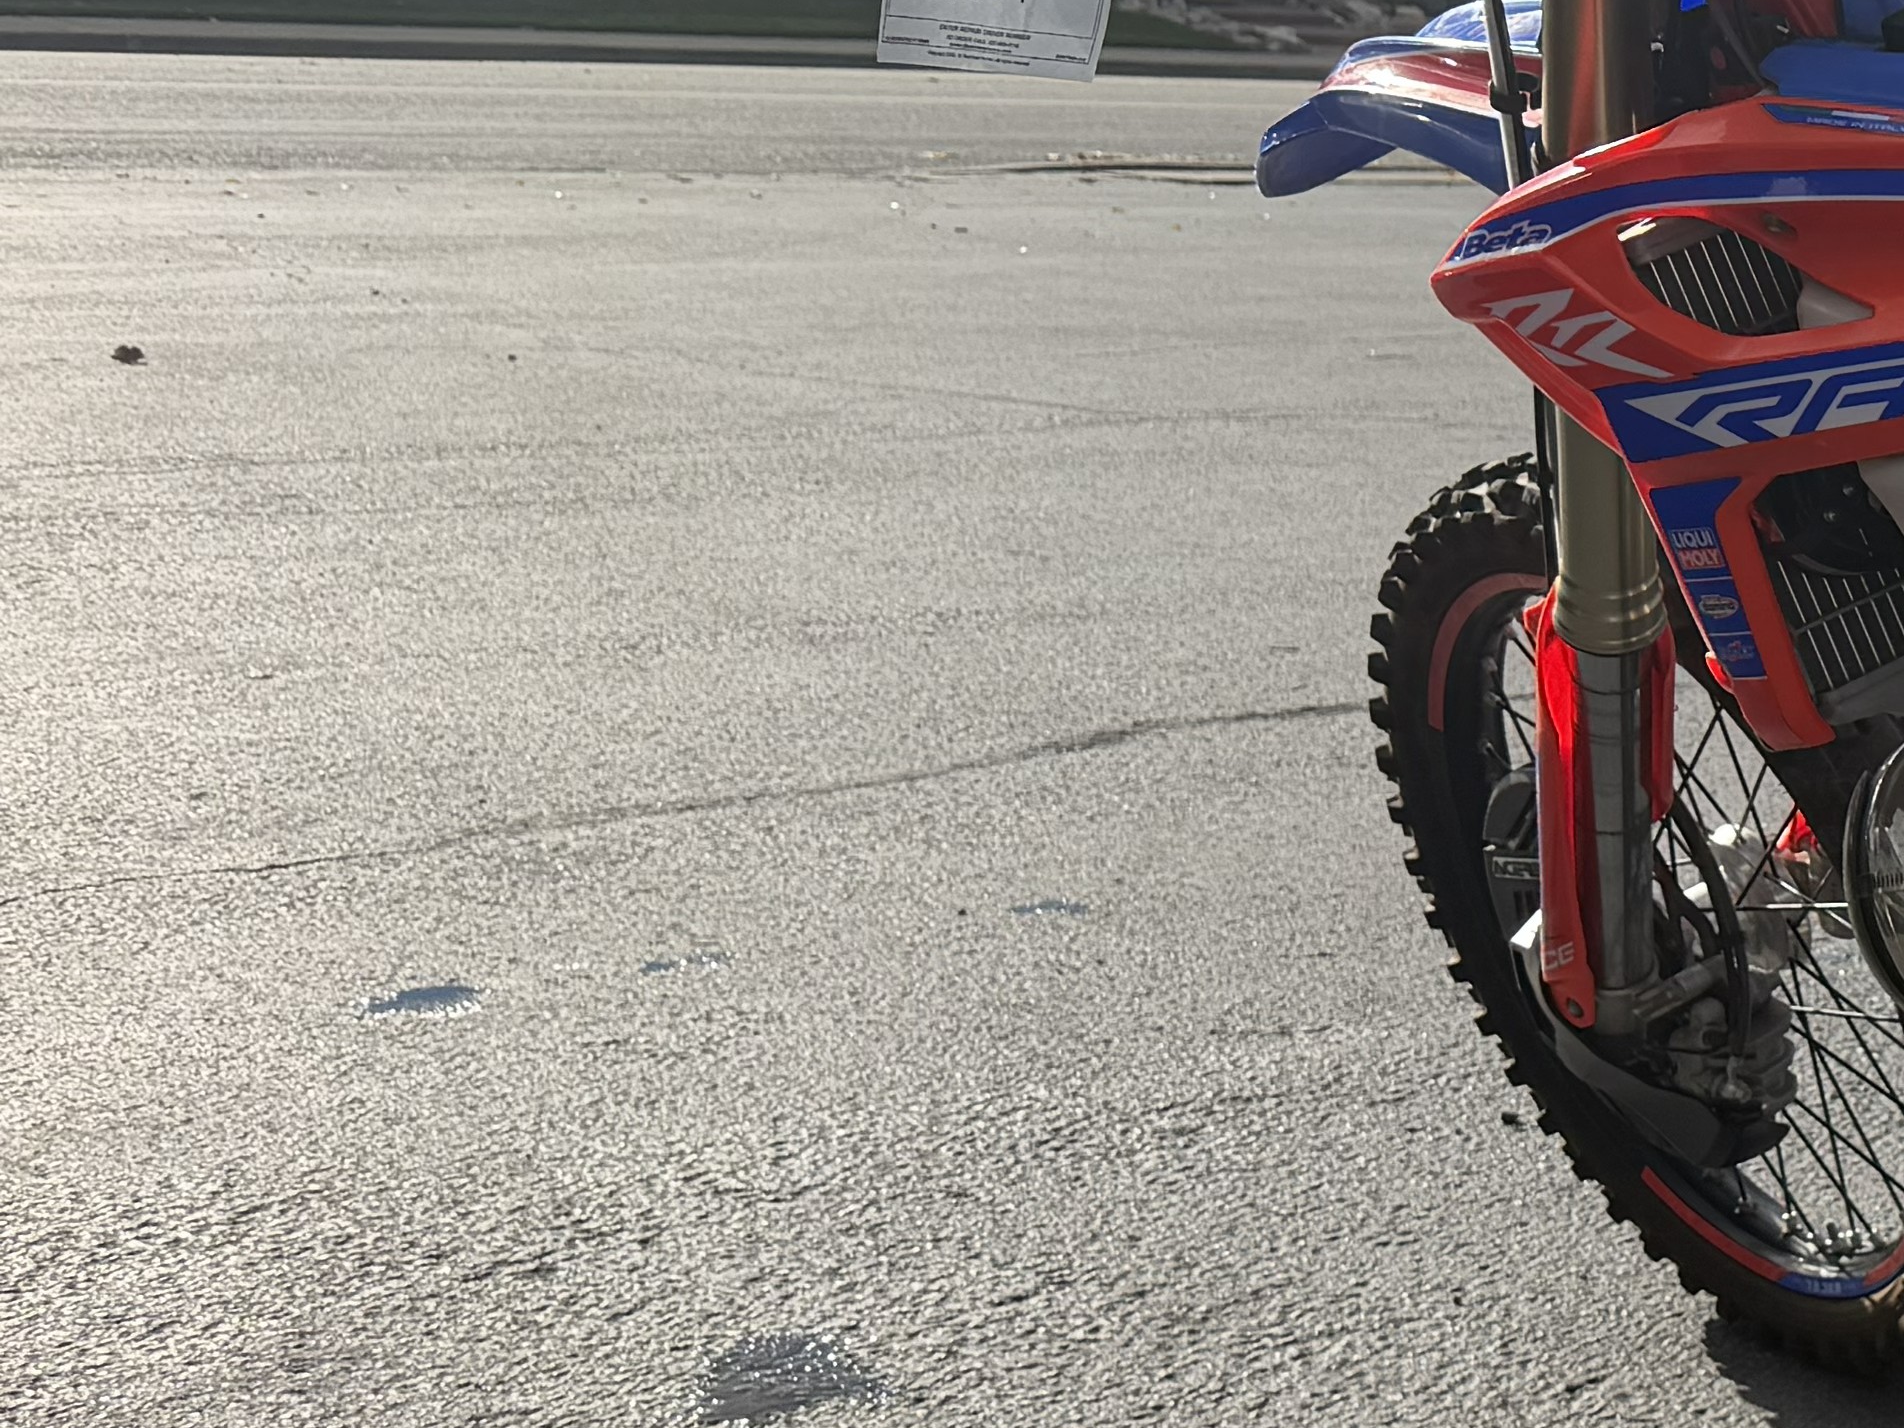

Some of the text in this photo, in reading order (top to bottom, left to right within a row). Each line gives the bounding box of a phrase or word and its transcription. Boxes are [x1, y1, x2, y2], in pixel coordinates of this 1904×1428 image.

[1462, 222, 1548, 258] Beta
[1672, 528, 1714, 549] LIQUI
[1678, 548, 1721, 567] MOLY
